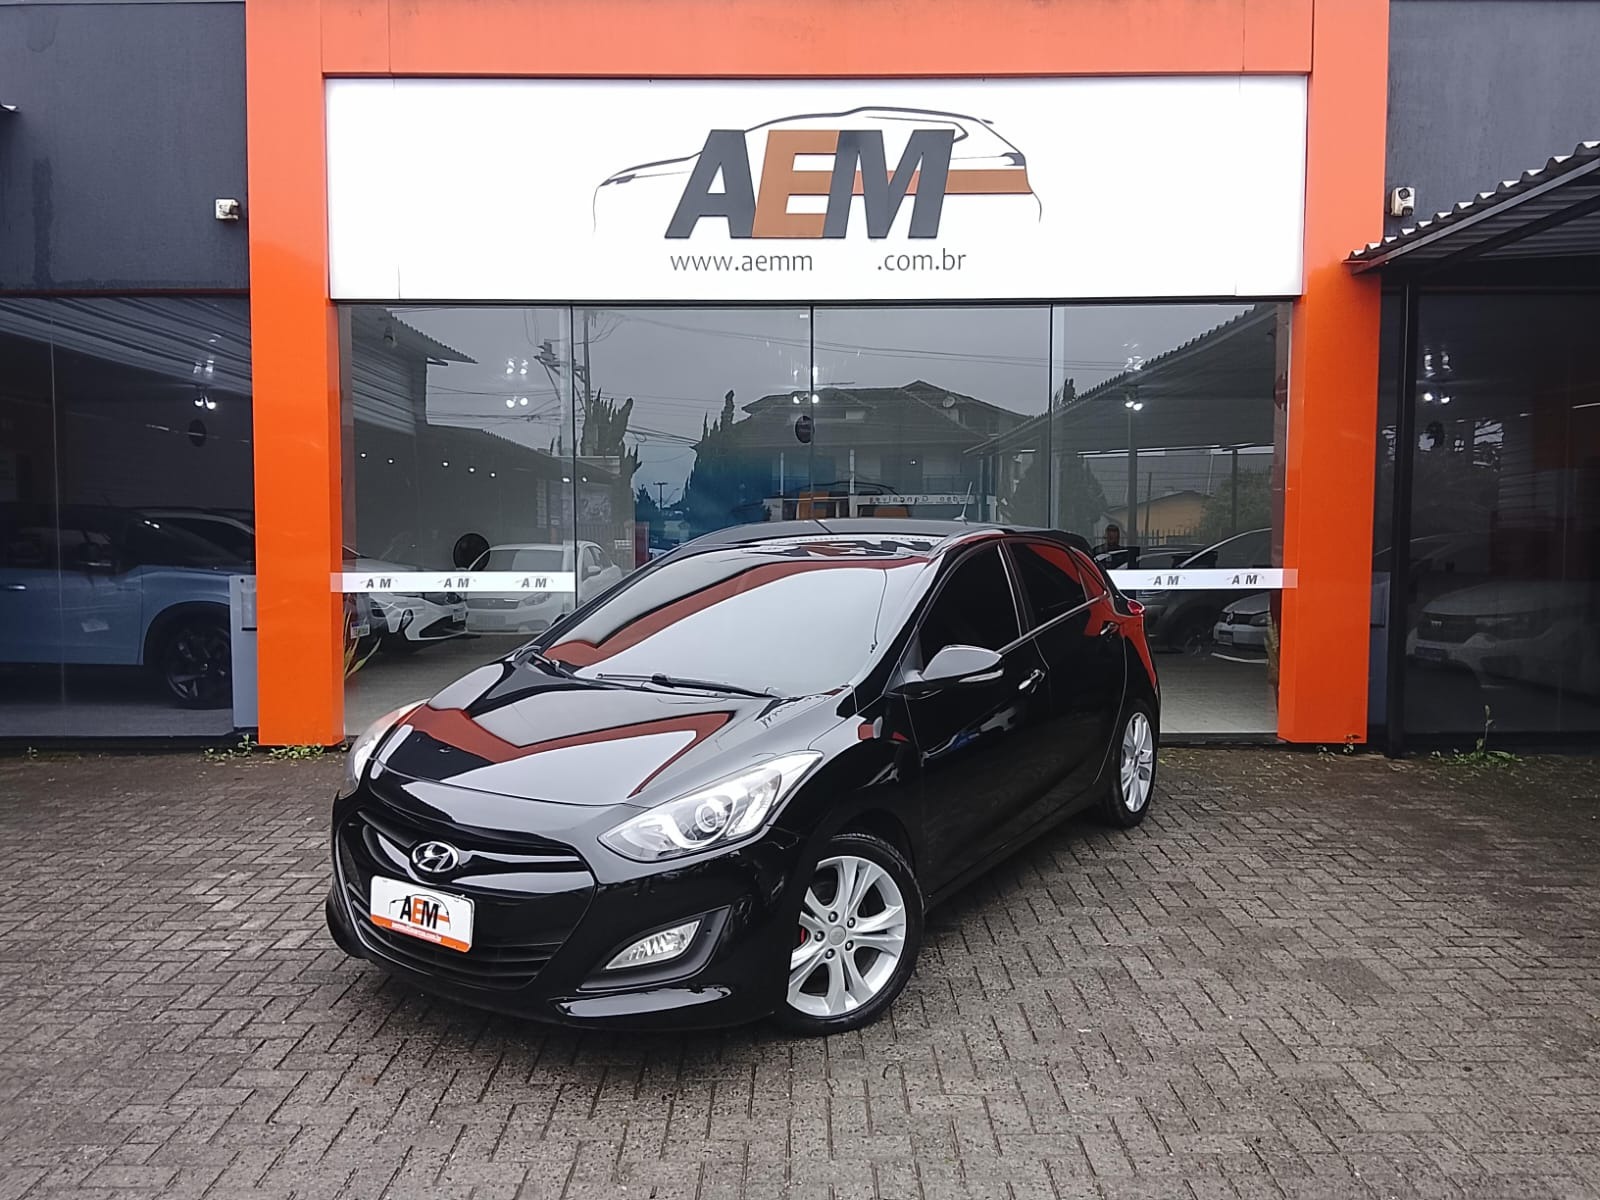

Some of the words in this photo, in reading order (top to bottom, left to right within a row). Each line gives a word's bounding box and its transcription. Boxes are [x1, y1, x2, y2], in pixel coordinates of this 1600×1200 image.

[664, 129, 956, 239] AEM
[670, 254, 814, 273] www.aemm
[877, 248, 967, 273] .com.br
[400, 895, 439, 929] AEM
